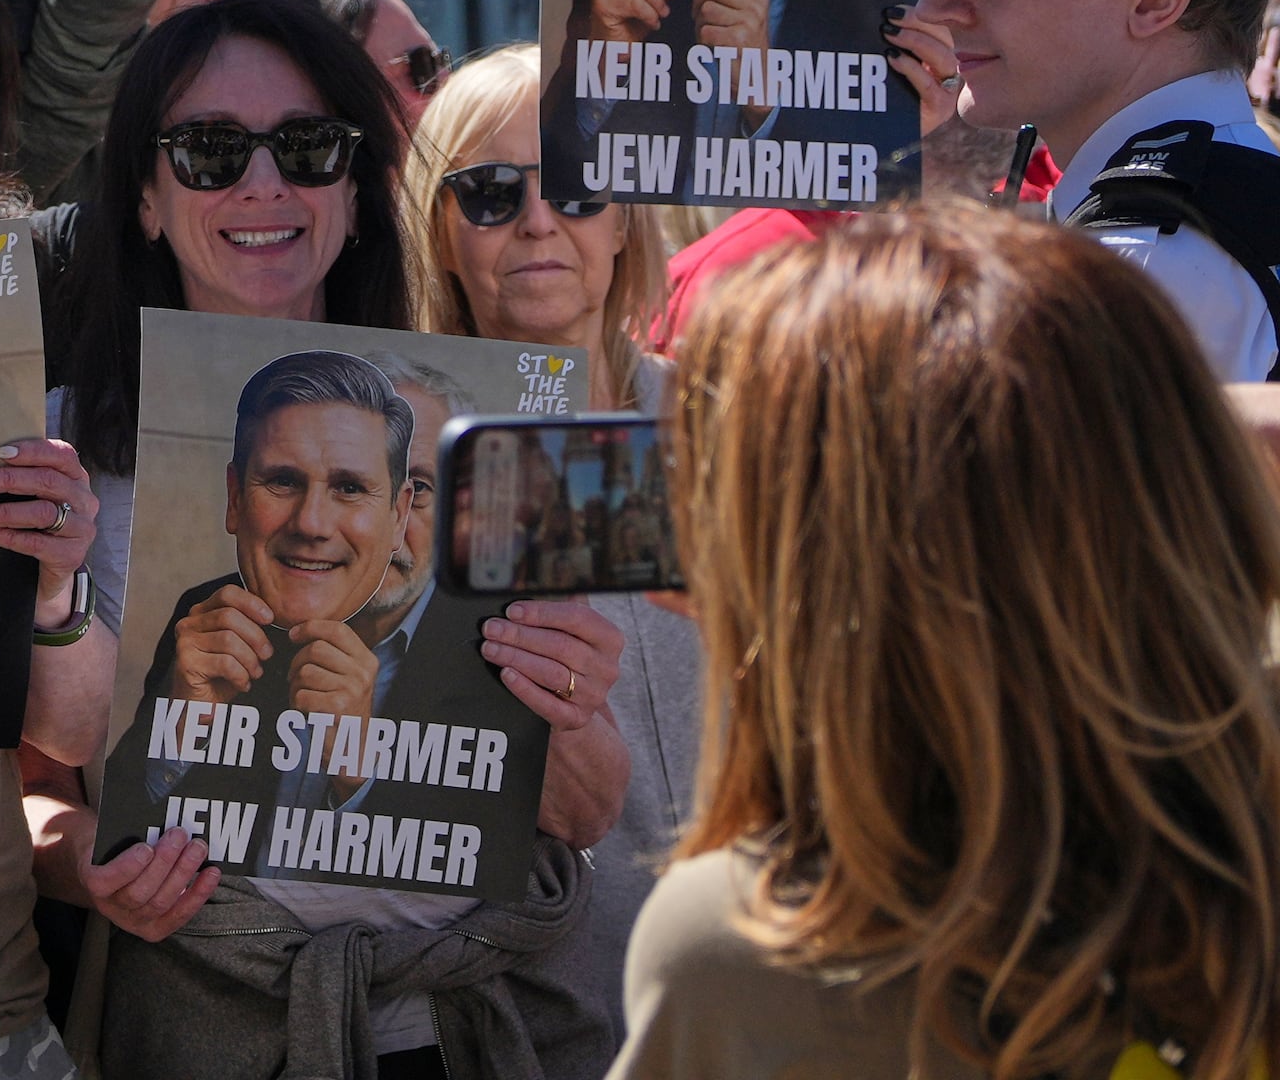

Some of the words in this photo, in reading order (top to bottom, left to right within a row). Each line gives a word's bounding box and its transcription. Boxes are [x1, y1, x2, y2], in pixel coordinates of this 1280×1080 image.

[575, 39, 674, 104] KEIR
[685, 44, 889, 115] STARMER
[582, 132, 681, 195] JEW
[692, 136, 879, 204] HARMER
[1129, 151, 1171, 163] NW
[517, 391, 570, 416] HATE
[524, 373, 567, 396] THE
[146, 696, 261, 769] KEIR
[270, 708, 509, 794] STARMER
[266, 805, 483, 887] HARMER
